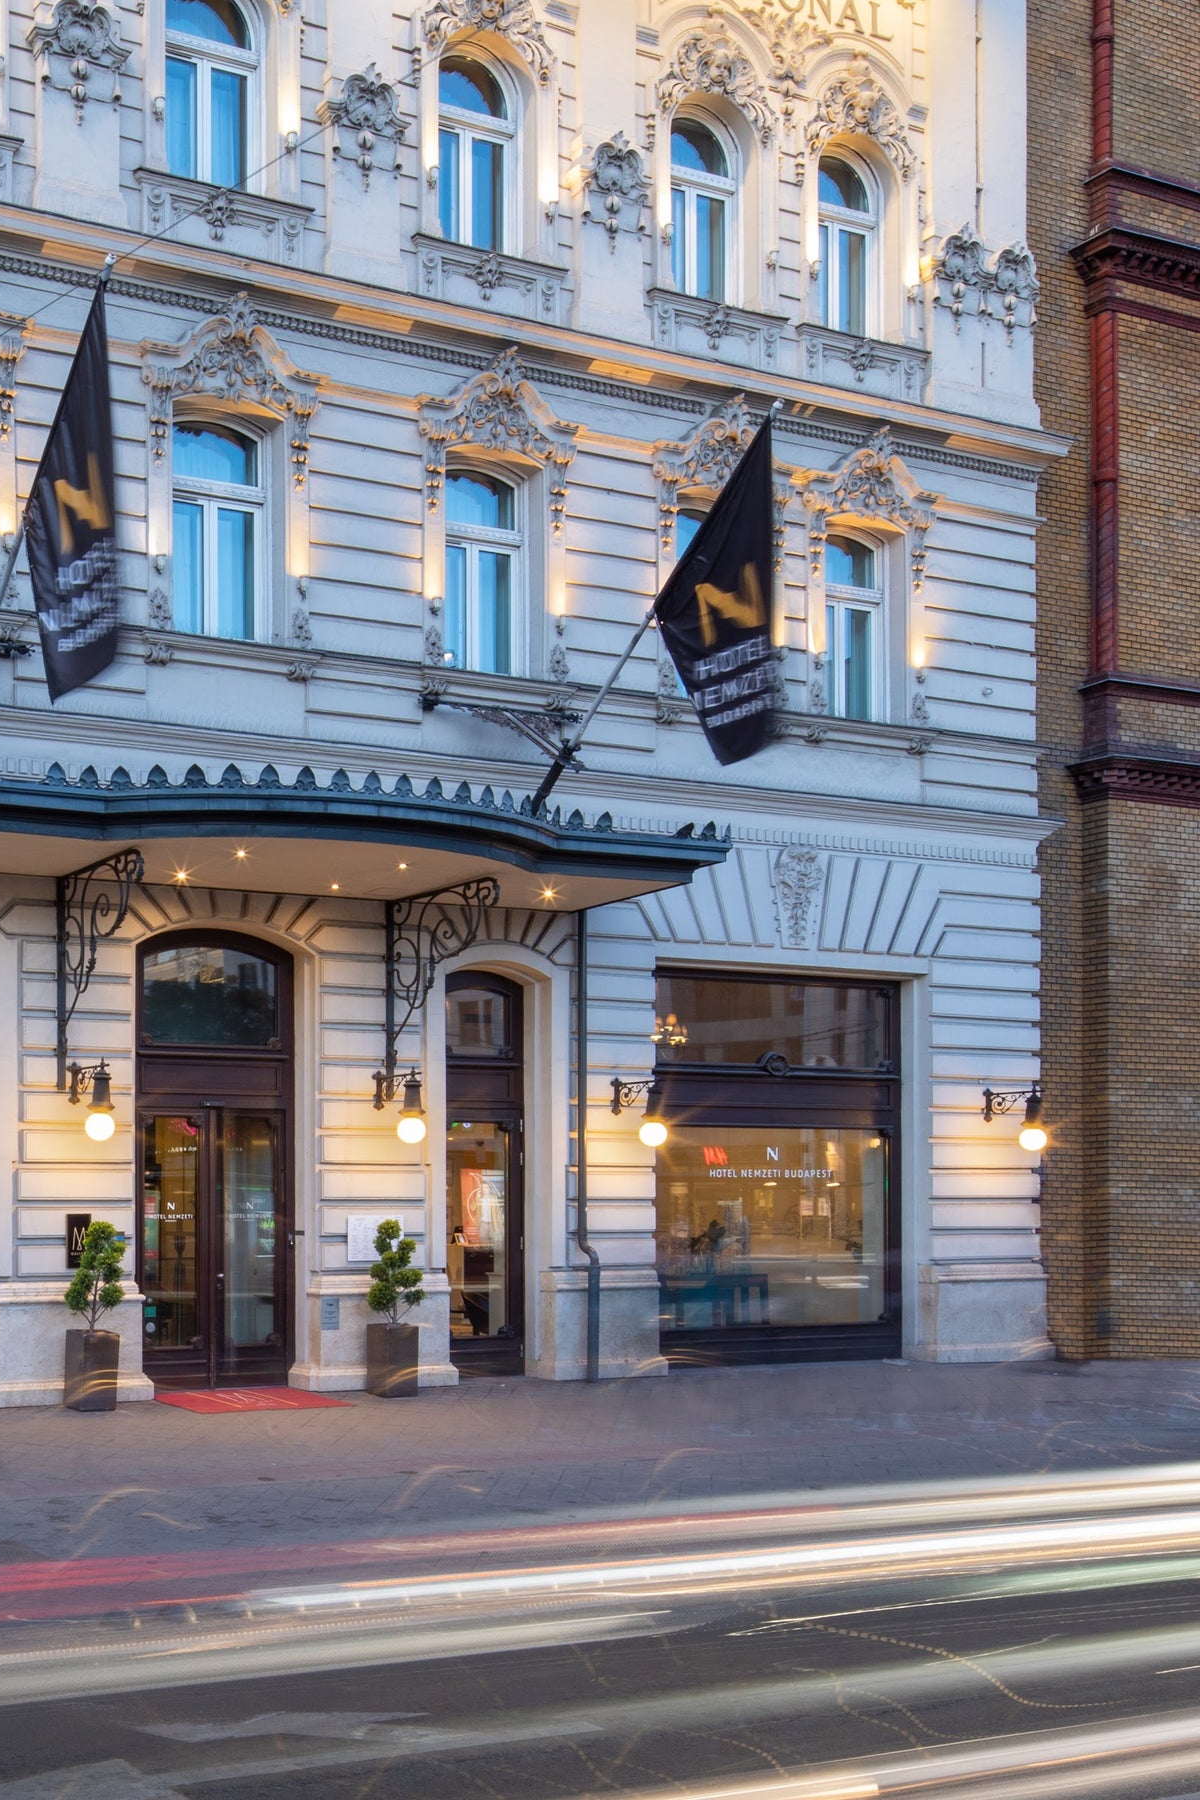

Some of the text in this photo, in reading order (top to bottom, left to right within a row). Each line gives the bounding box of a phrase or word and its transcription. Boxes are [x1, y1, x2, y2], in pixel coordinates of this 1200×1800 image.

[766, 1147, 779, 1160] N
[709, 1169, 832, 1178] HOTEL NEMZETI BUDAPEST
[166, 1201, 176, 1210] N
